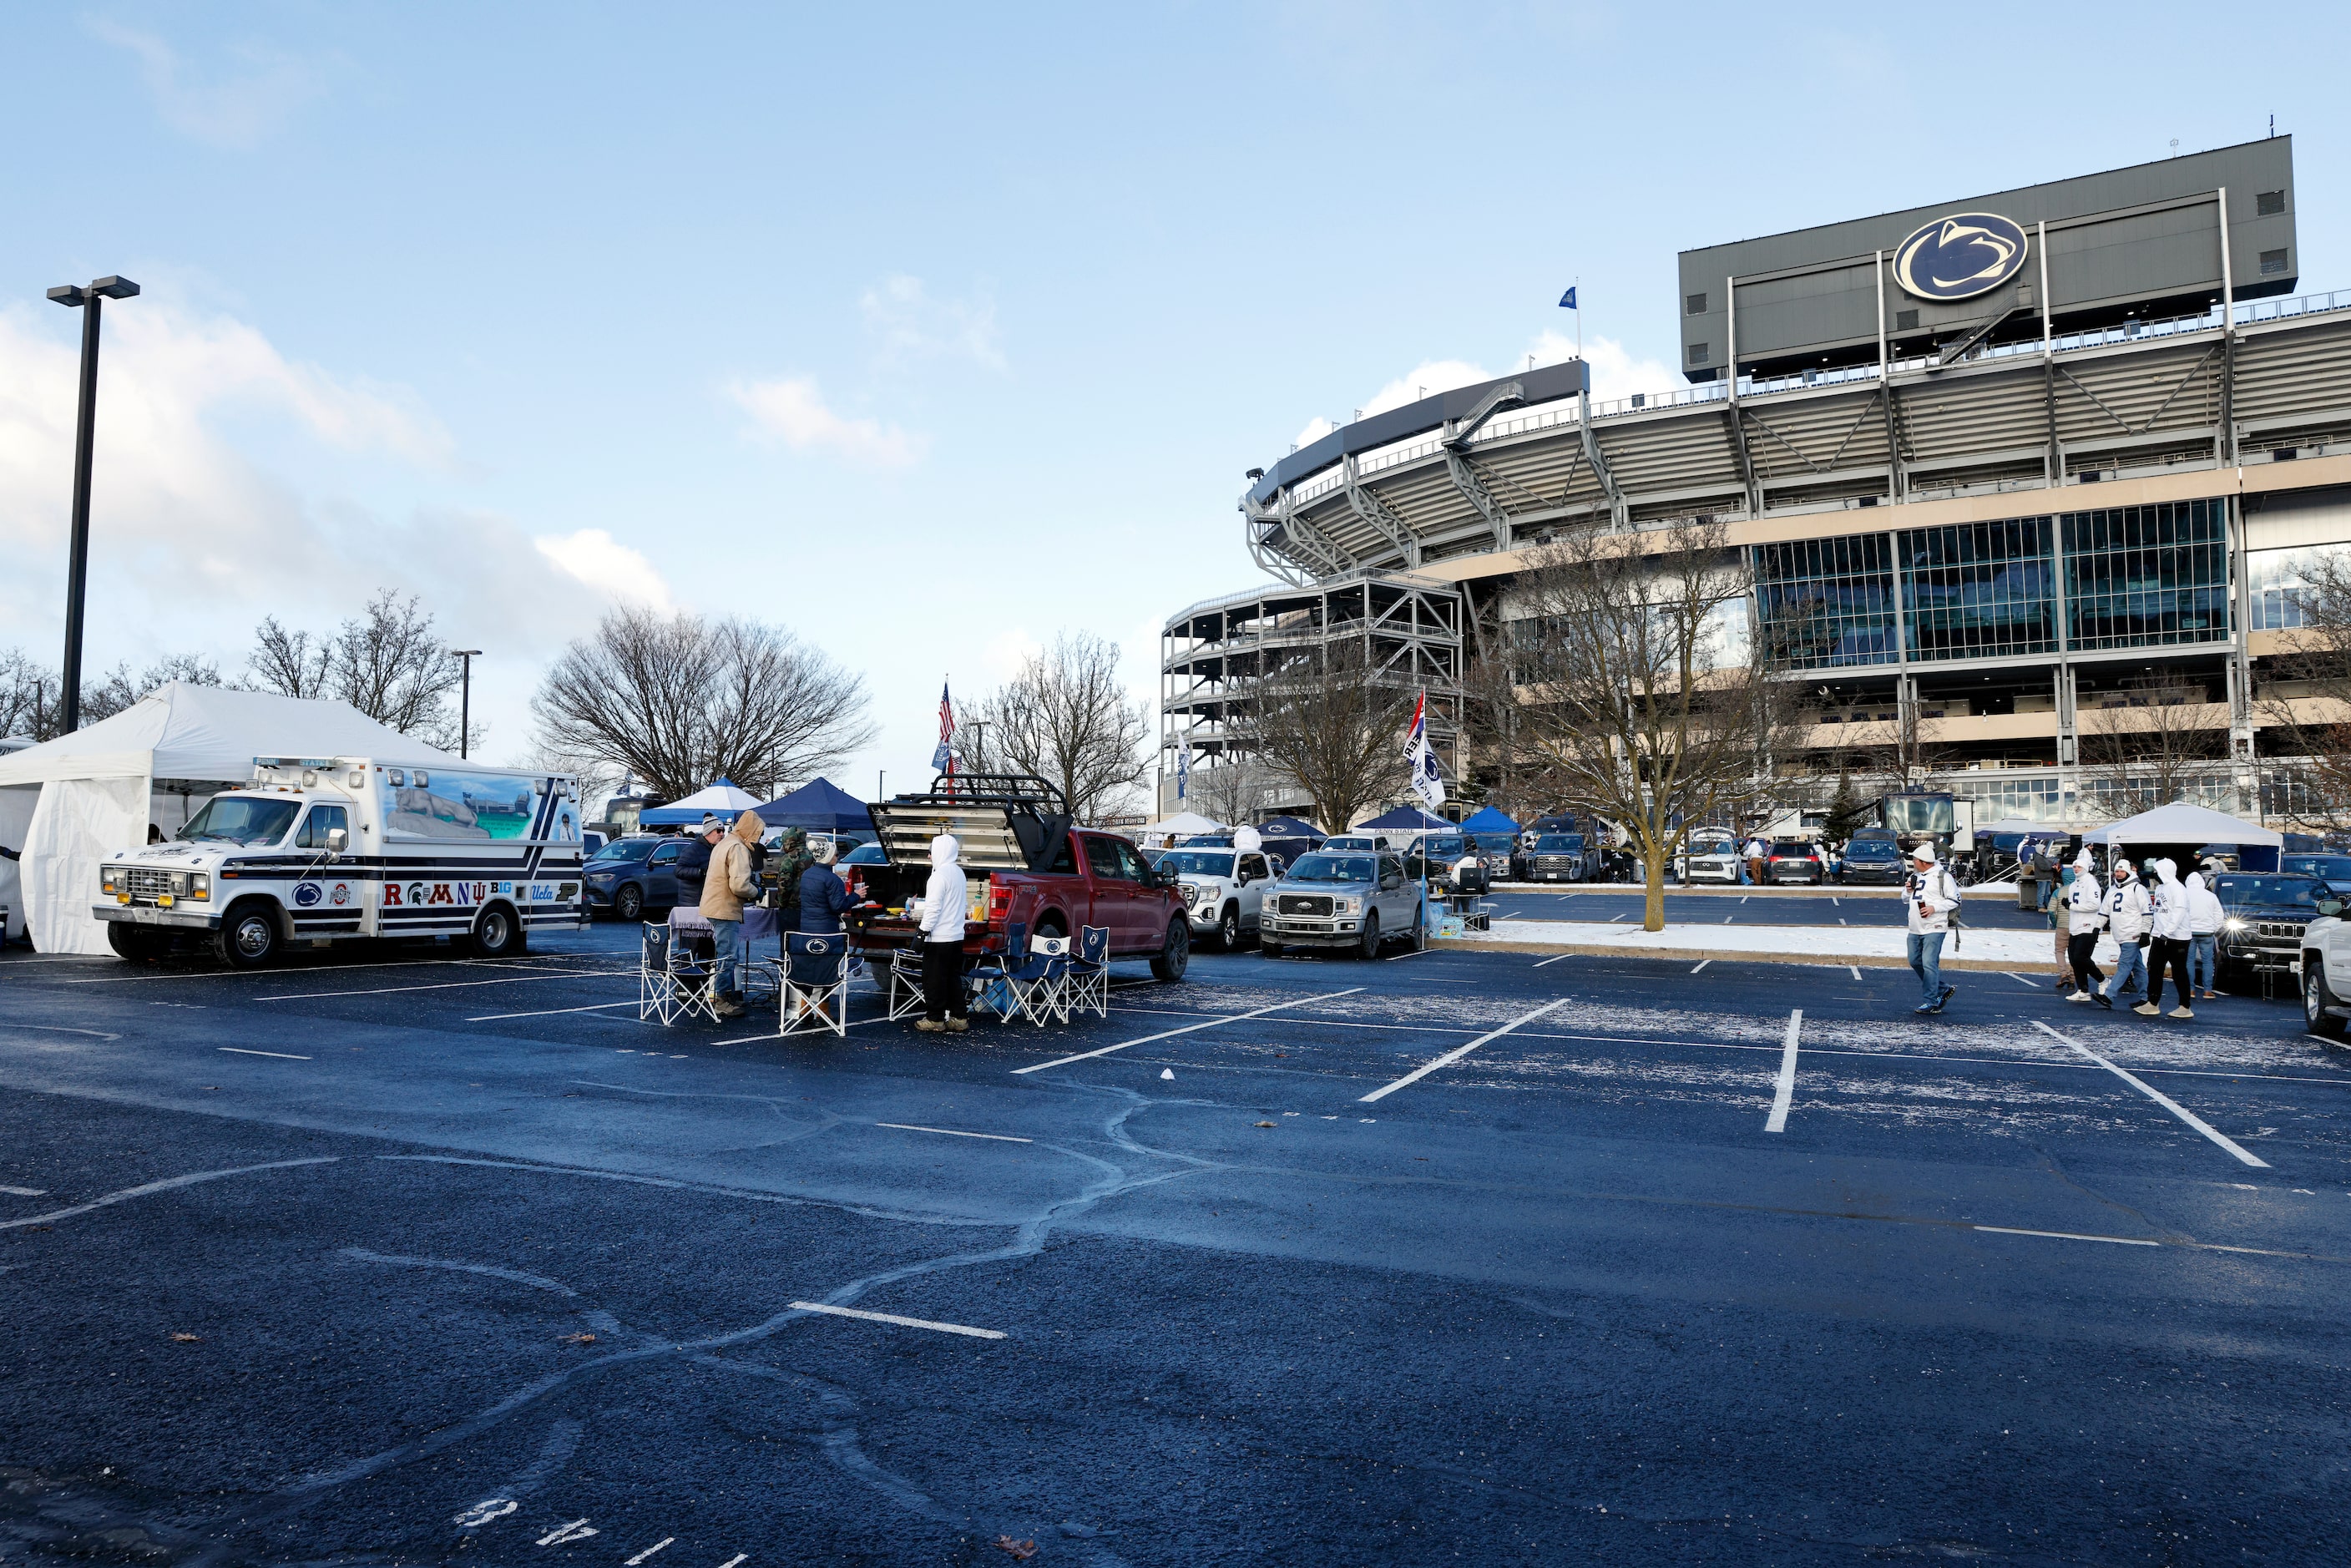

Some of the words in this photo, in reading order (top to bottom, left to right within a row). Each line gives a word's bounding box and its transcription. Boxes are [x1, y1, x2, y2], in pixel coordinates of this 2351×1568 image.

[1912, 768, 1923, 777] R3
[384, 883, 402, 906] R
[427, 884, 454, 905] M
[458, 882, 469, 905] N
[554, 883, 579, 902] P
[1019, 884, 1038, 894] FX4
[1912, 879, 1926, 900] 2
[2072, 892, 2080, 904] 5
[2112, 892, 2124, 913] 2
